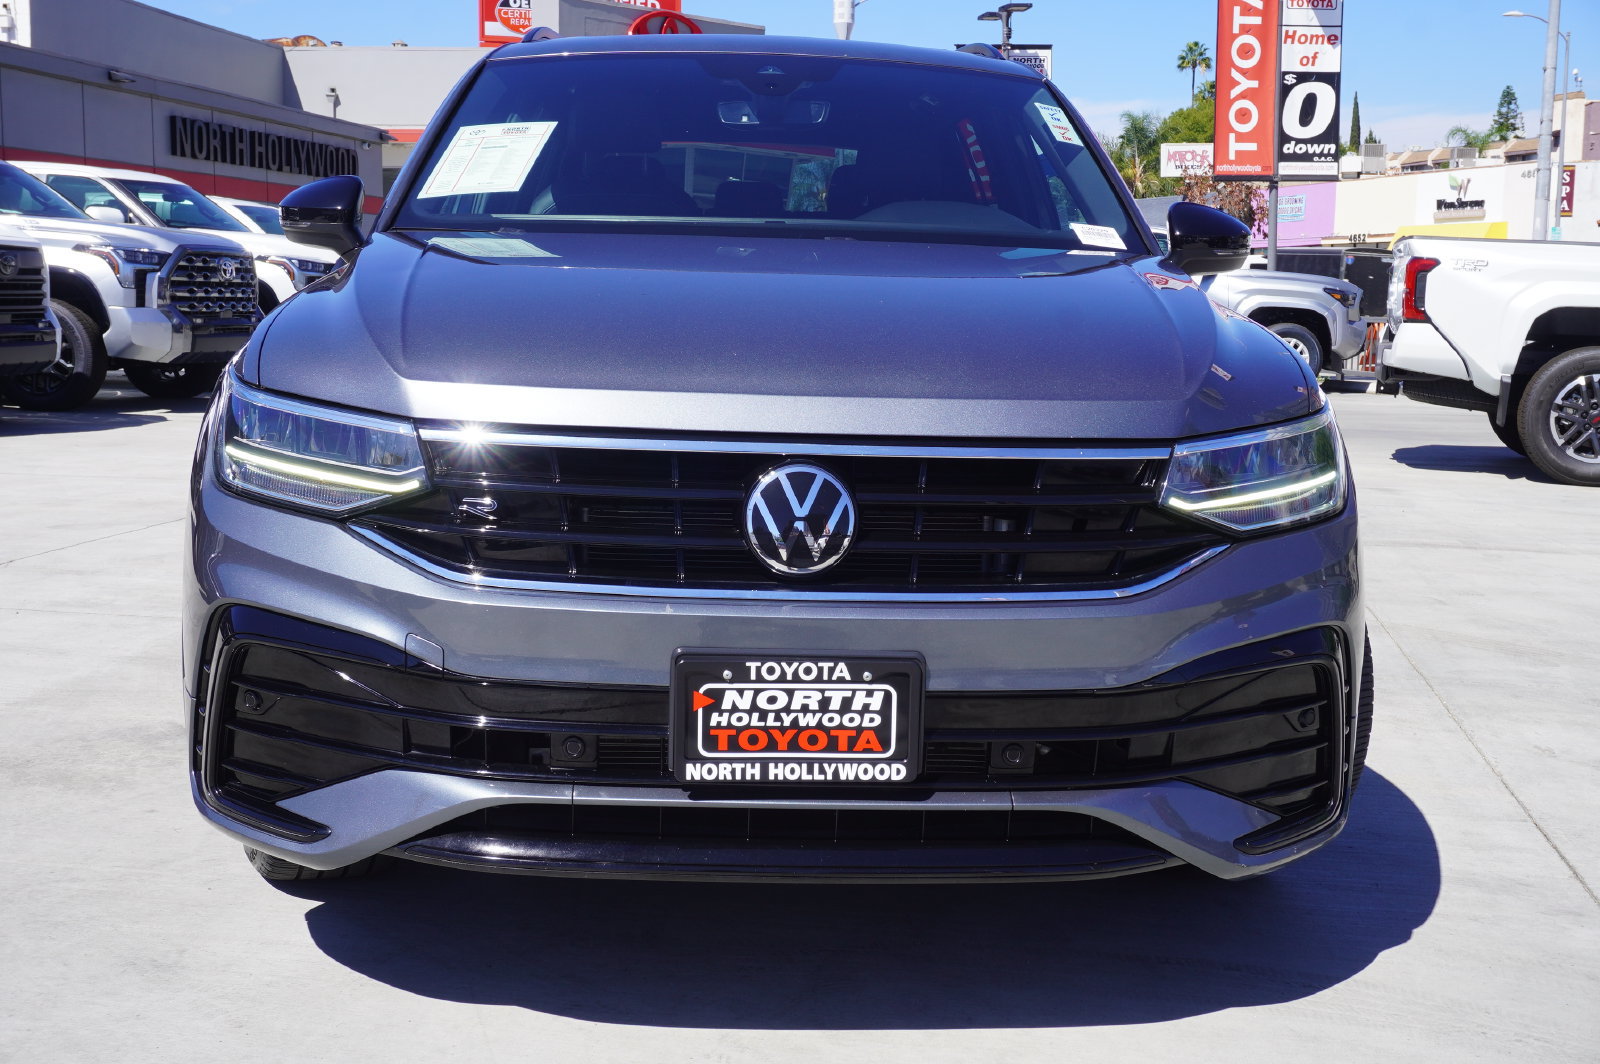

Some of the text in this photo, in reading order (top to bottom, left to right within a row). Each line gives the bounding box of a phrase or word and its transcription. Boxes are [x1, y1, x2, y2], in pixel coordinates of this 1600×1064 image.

[1283, 29, 1339, 46] Home
[1299, 52, 1319, 67] of
[170, 115, 360, 178] NORTH HOLLYWOOD
[1283, 141, 1337, 154] down
[1560, 171, 1571, 211] SPA
[1348, 234, 1367, 243] 4652
[745, 661, 852, 681] TOYOTA
[720, 689, 885, 711] NORTH
[709, 712, 882, 727] HOLLYWOOD
[709, 728, 883, 752] TOYOTA
[685, 762, 907, 781] NORTH HOLLYWOOD
